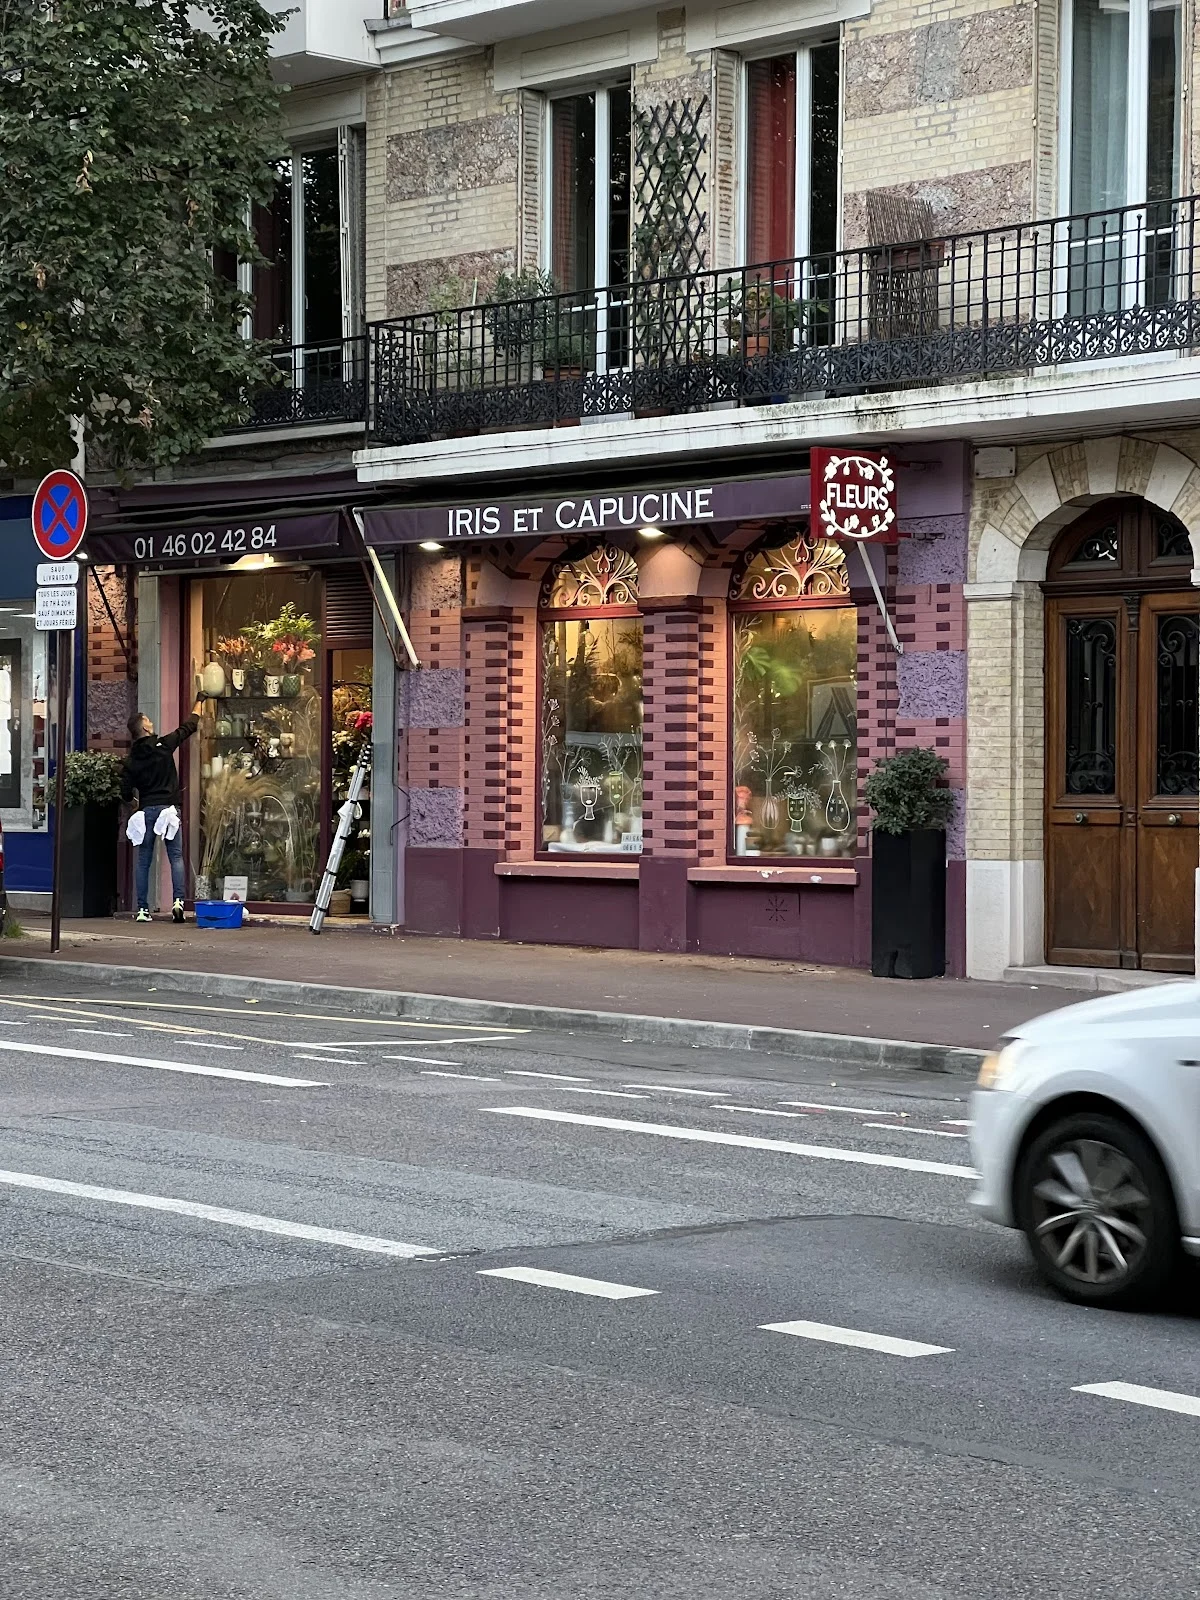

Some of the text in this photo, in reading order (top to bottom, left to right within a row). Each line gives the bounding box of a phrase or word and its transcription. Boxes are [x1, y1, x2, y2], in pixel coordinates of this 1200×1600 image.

[826, 482, 889, 511] FLEURS
[447, 487, 714, 536] IRIS ET CAPUCINE
[134, 524, 277, 559] 01 46 02 42 84
[50, 565, 65, 573] SAUF
[38, 590, 50, 598] TOUS
[50, 590, 59, 598] LES
[51, 609, 75, 617] DIMANCHE
[43, 619, 58, 627] JOURS
[59, 618, 75, 626] FÉRIÉS
